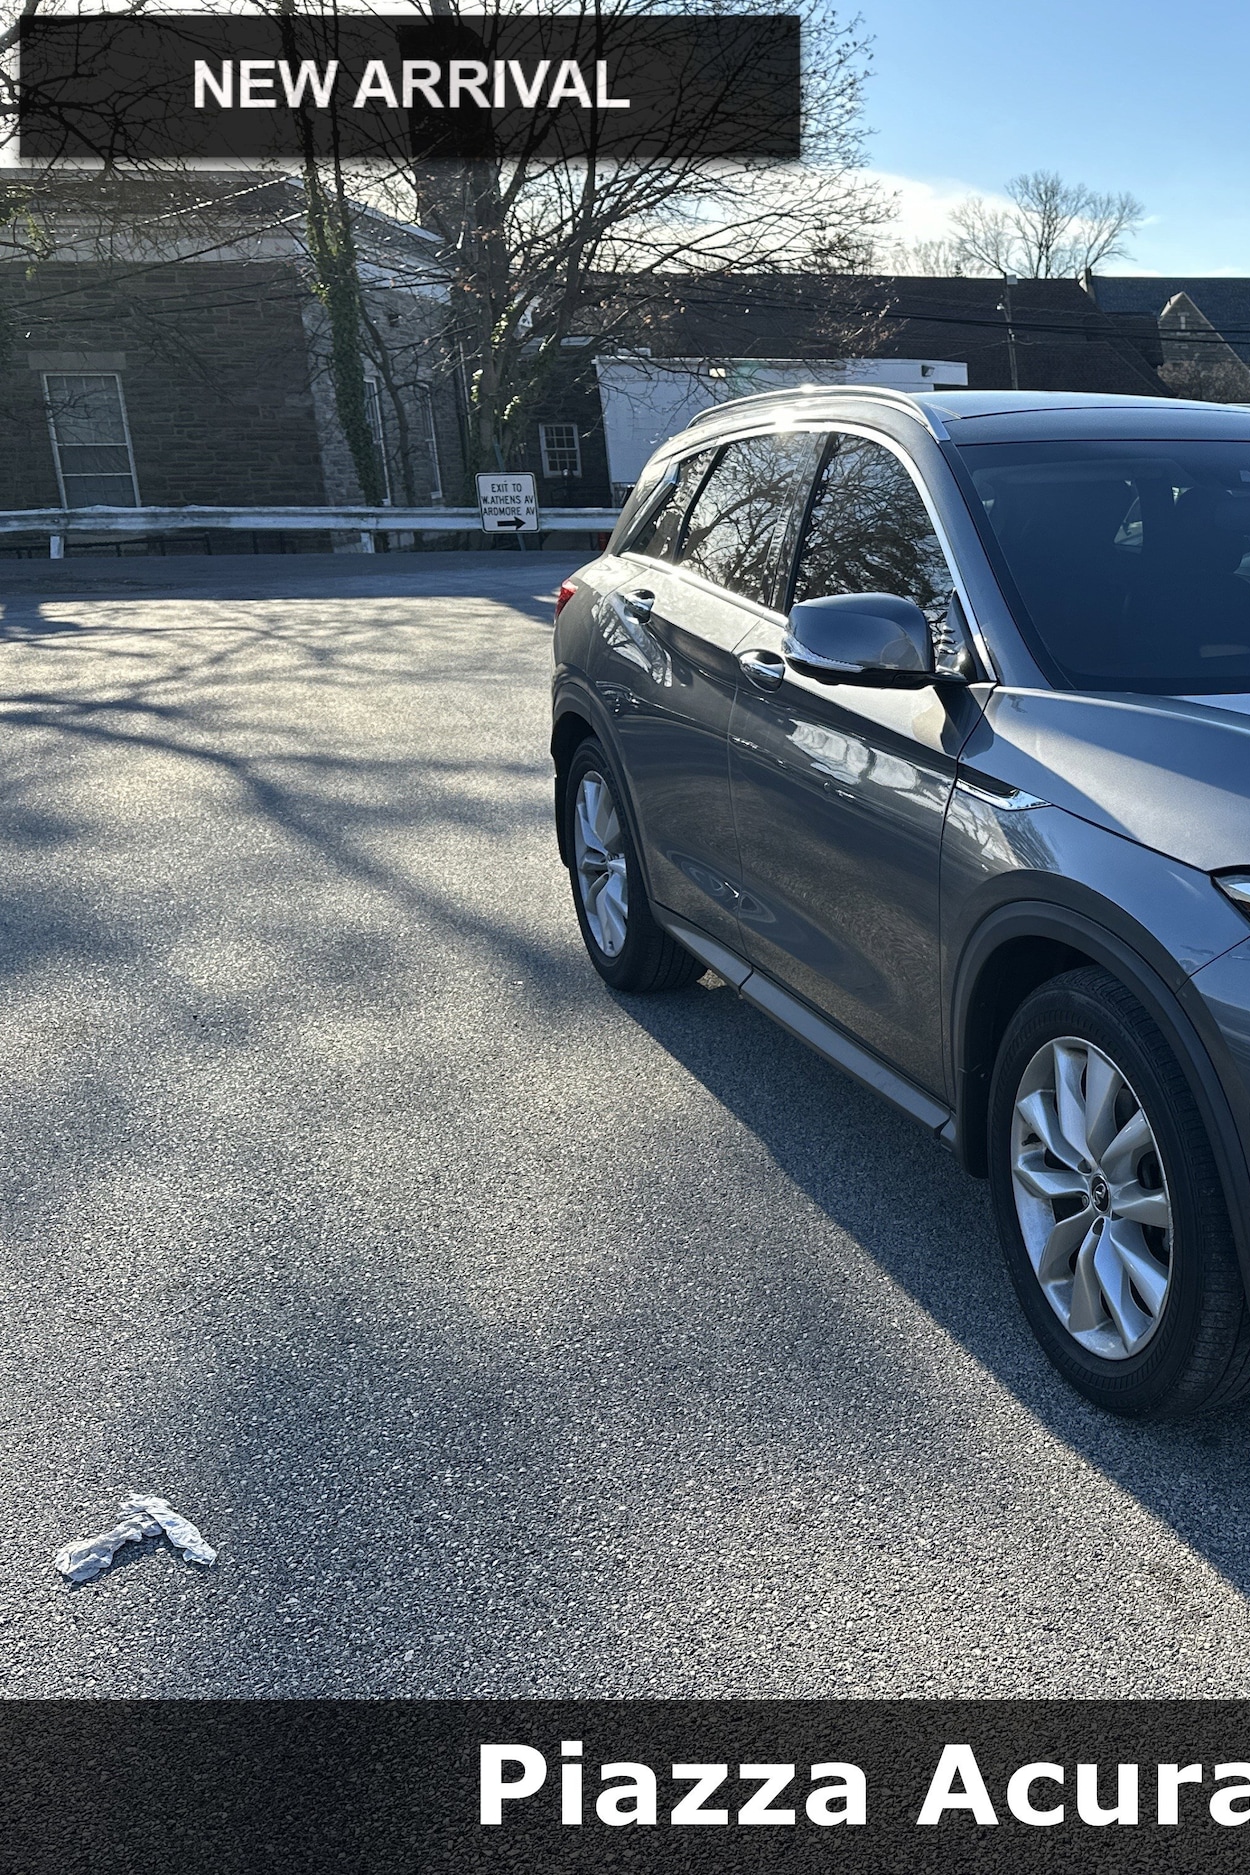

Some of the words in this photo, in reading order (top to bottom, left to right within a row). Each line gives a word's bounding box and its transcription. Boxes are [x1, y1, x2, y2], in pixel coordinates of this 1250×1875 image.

[491, 484, 508, 493] EXIT
[512, 483, 522, 493] TO
[524, 496, 533, 504] AV
[483, 507, 521, 516] ARDMORE
[526, 507, 535, 515] AV
